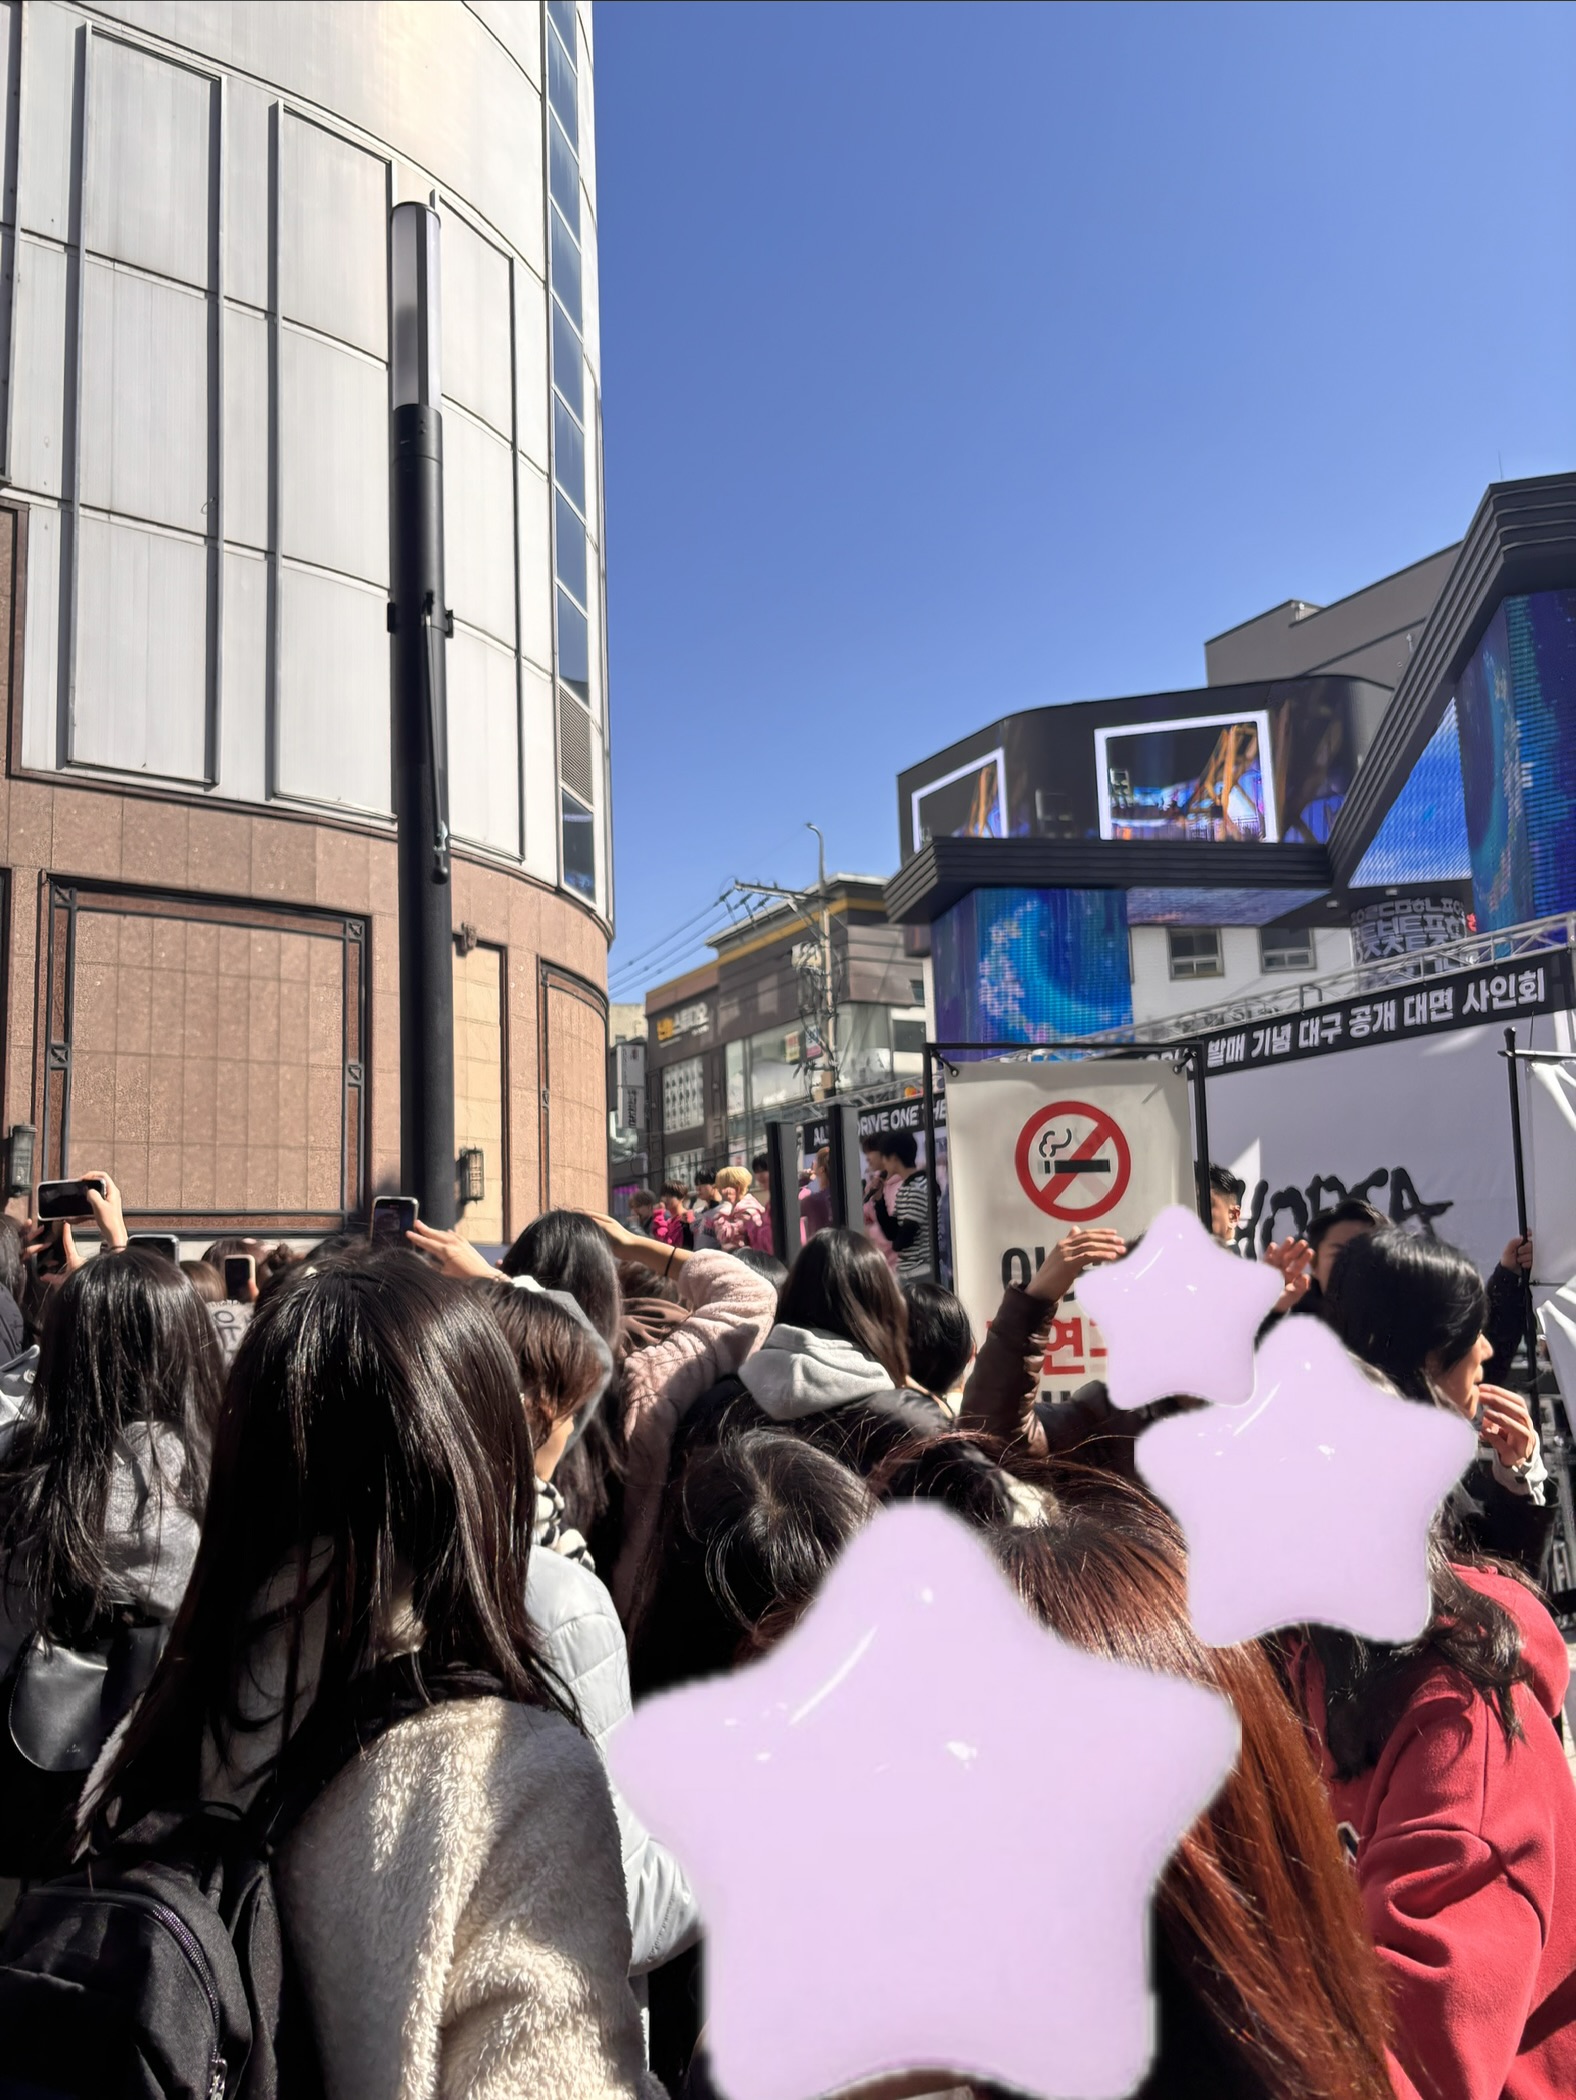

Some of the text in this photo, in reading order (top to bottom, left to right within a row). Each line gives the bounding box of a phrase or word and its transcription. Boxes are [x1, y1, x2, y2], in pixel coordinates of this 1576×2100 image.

[1207, 1033, 1246, 1068] 발매
[1251, 1022, 1292, 1058] 기념
[1298, 1014, 1343, 1049] 대구
[1349, 999, 1397, 1038] 공개
[1403, 987, 1455, 1027] 대면
[1462, 967, 1546, 1016] 사인회
[890, 1105, 920, 1130] ONE
[921, 1100, 947, 1122] HE
